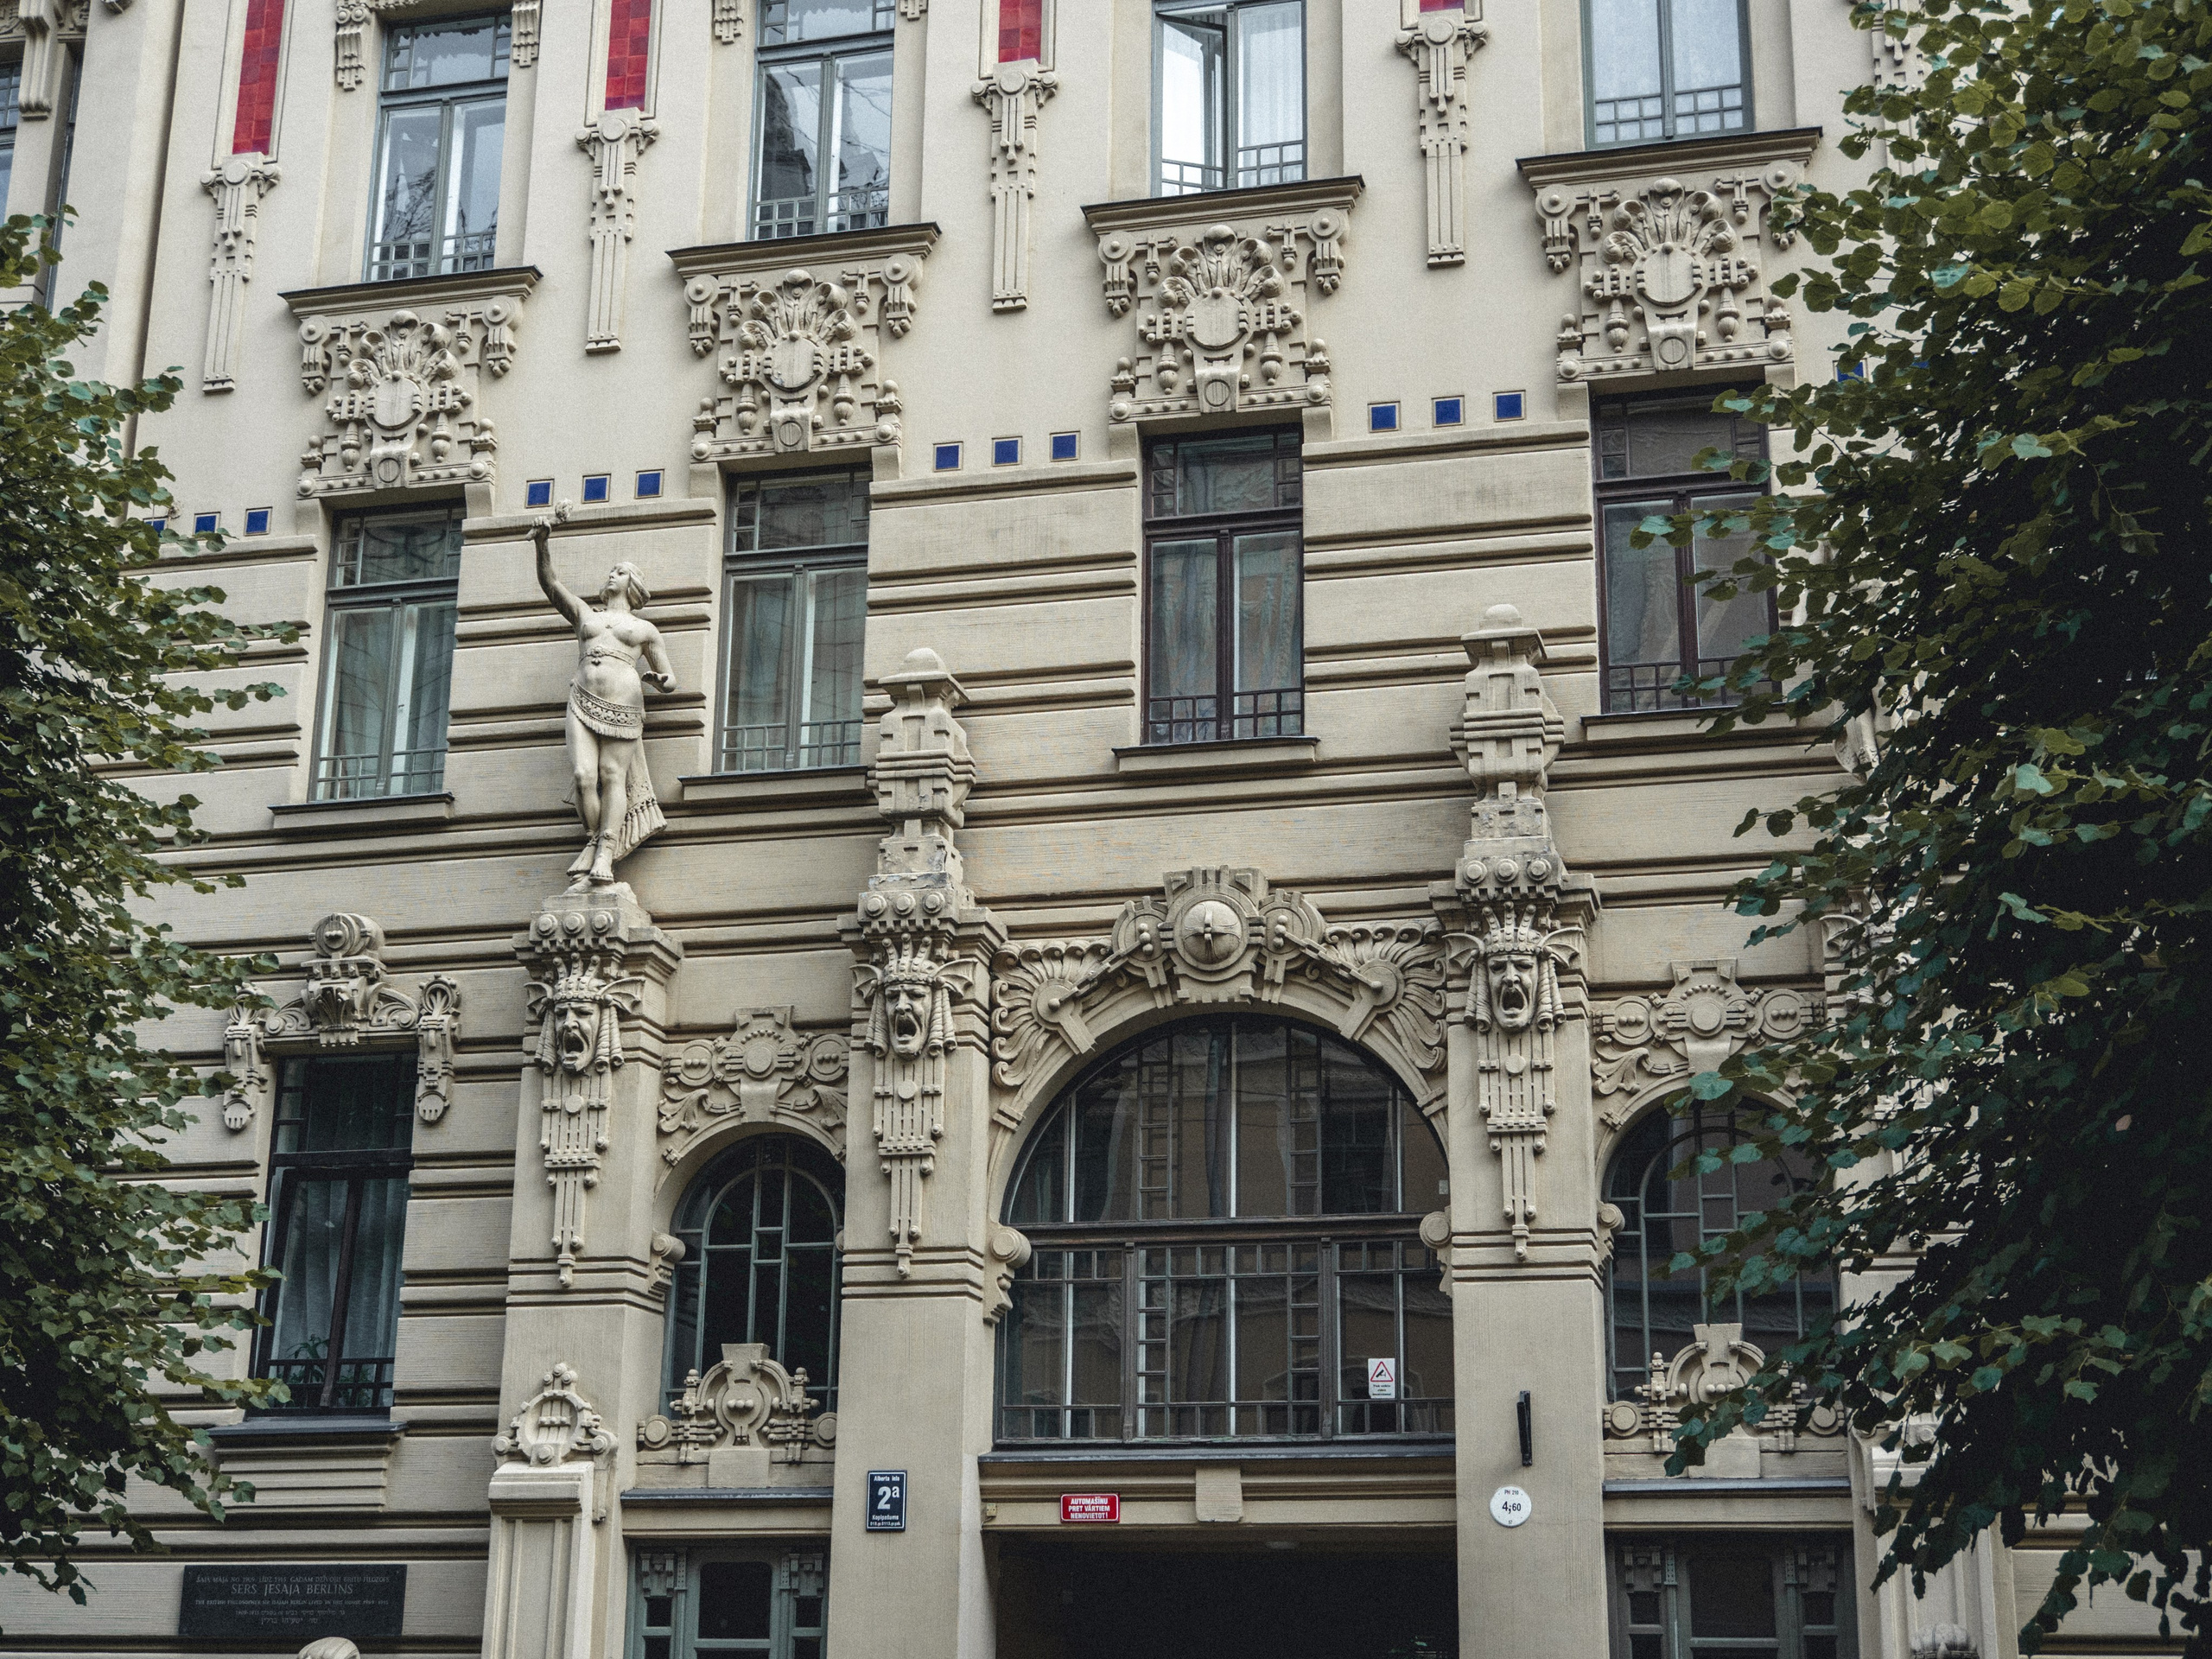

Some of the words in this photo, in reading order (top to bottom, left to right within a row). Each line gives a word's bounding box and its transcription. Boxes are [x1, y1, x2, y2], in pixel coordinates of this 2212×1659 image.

[231, 1584, 257, 1594] SERS
[264, 1584, 301, 1597] JESAJA
[306, 1584, 354, 1594] BERLINS
